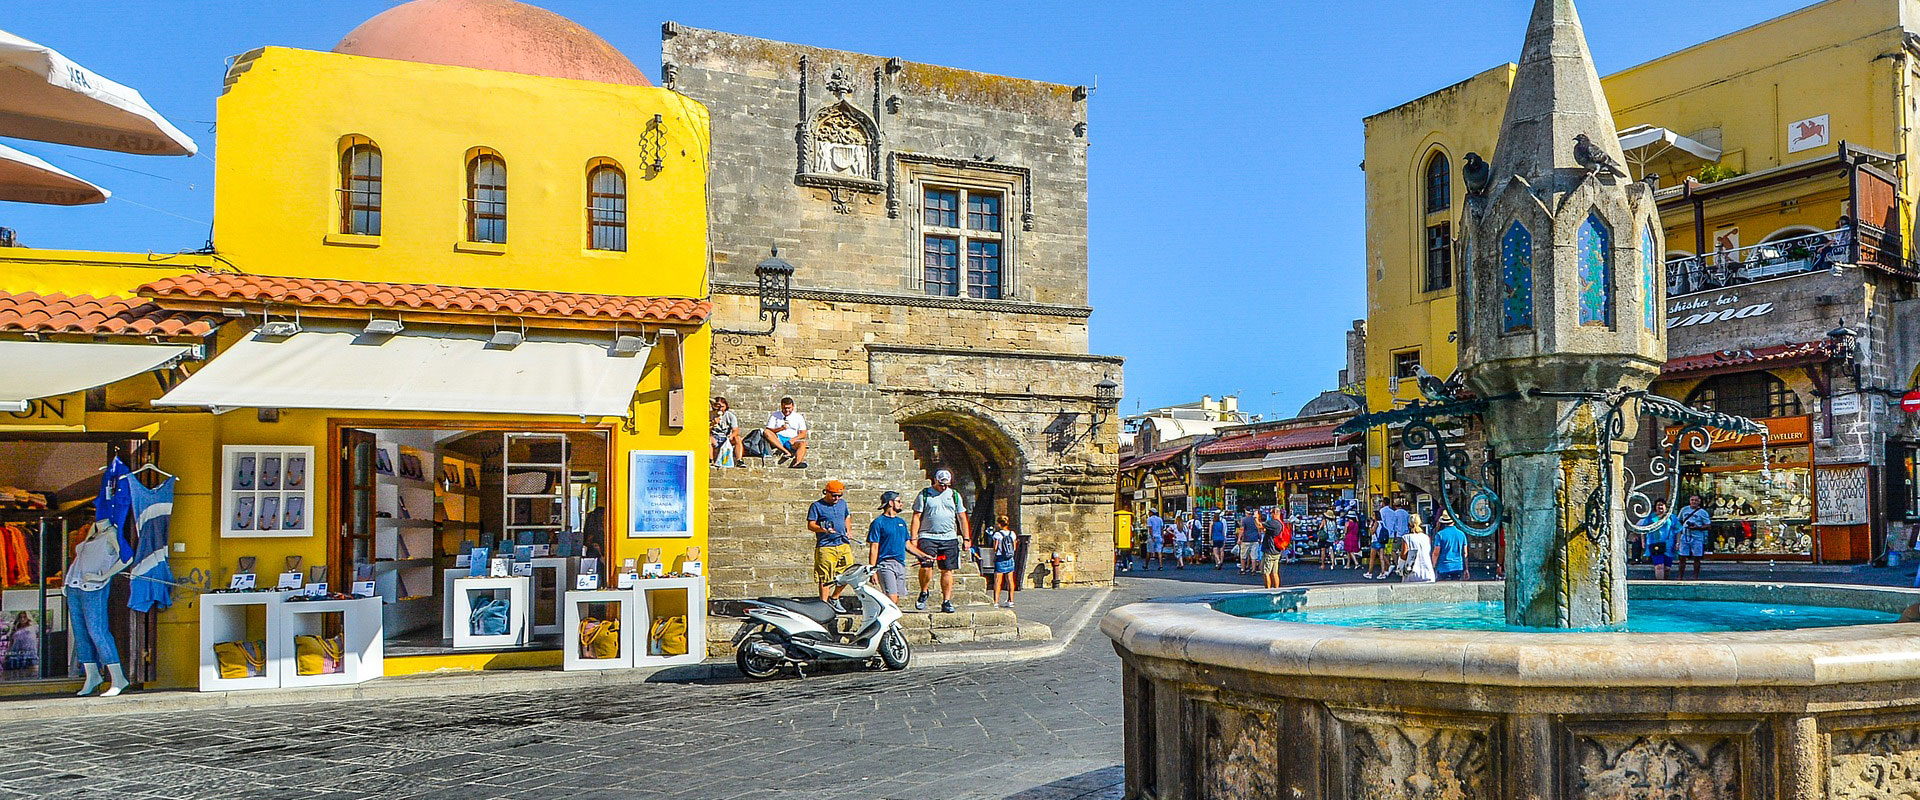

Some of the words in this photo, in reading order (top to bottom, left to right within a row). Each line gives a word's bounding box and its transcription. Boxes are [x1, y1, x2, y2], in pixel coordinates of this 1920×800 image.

[1668, 298, 1709, 314] shisha
[1716, 294, 1739, 306] bar
[1767, 431, 1804, 441] JEWELLERY
[1287, 471, 1299, 480] LA
[1303, 466, 1350, 480] FONTANA
